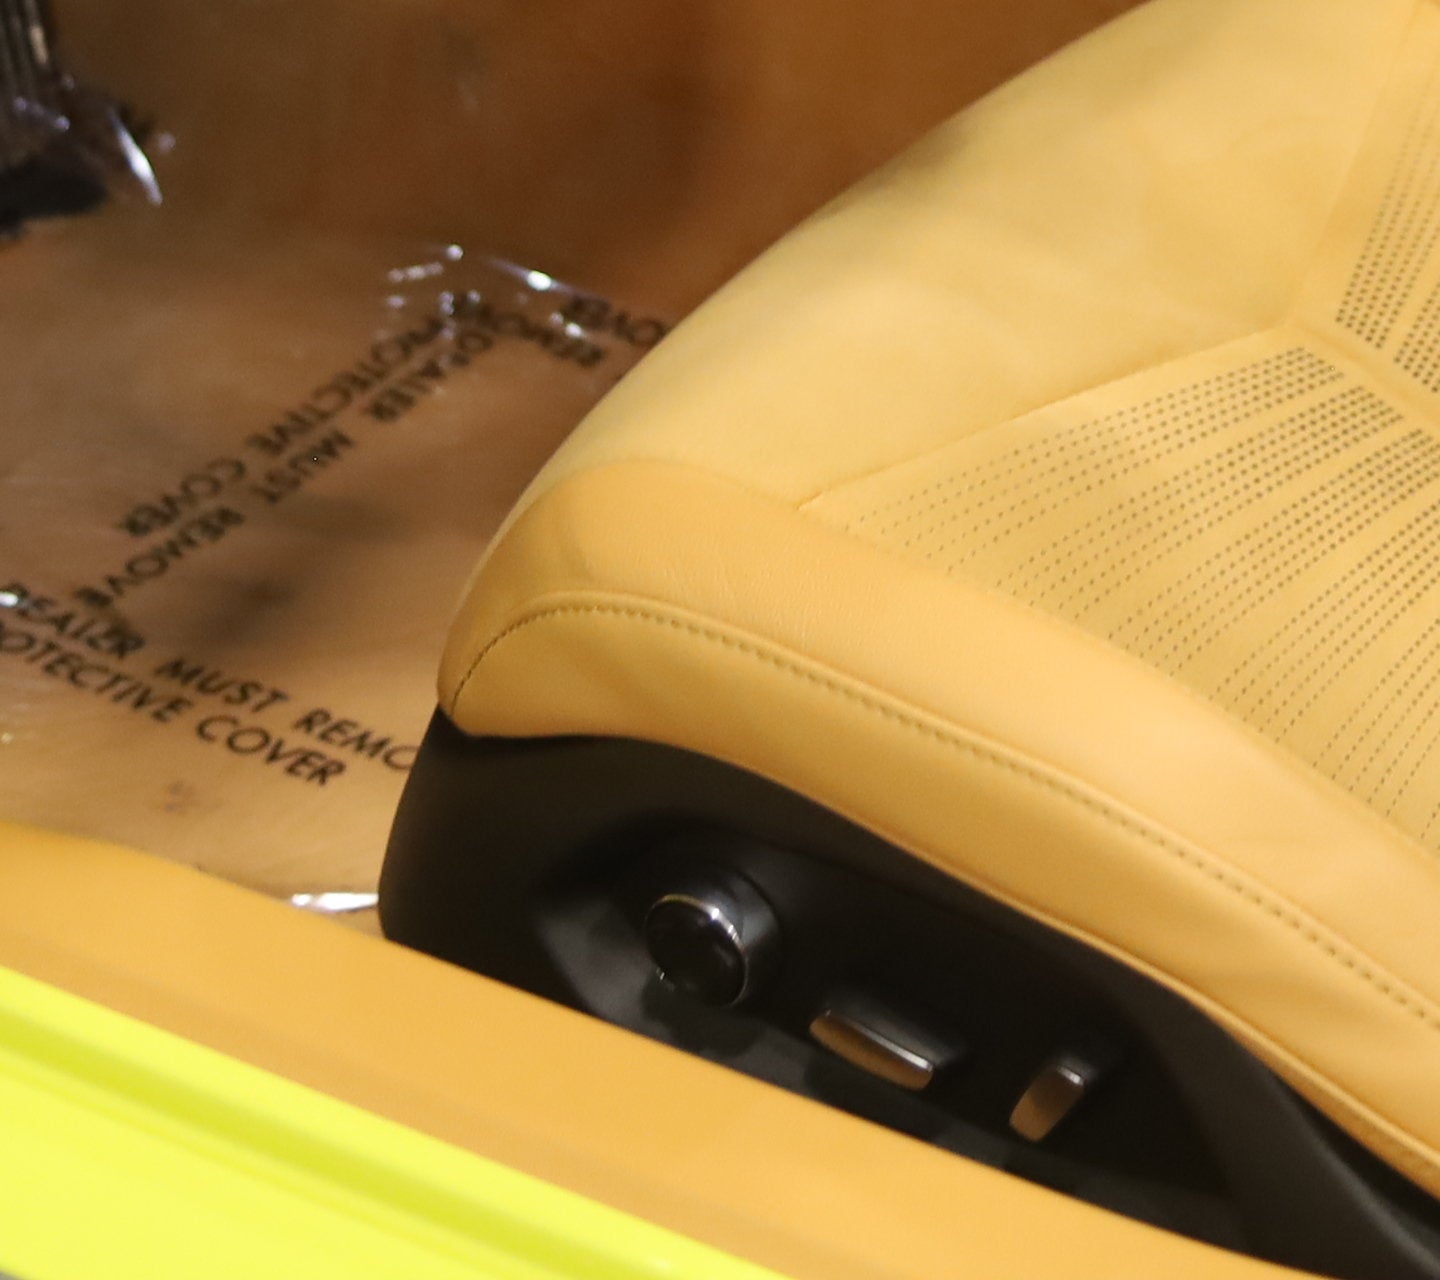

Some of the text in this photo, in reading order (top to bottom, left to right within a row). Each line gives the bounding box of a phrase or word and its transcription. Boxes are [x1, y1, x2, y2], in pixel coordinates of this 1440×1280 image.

[118, 455, 249, 540] COVER
[250, 428, 357, 507] MUST
[154, 655, 290, 715] MUST
[295, 707, 420, 772] REMO
[195, 713, 348, 788] COVER
